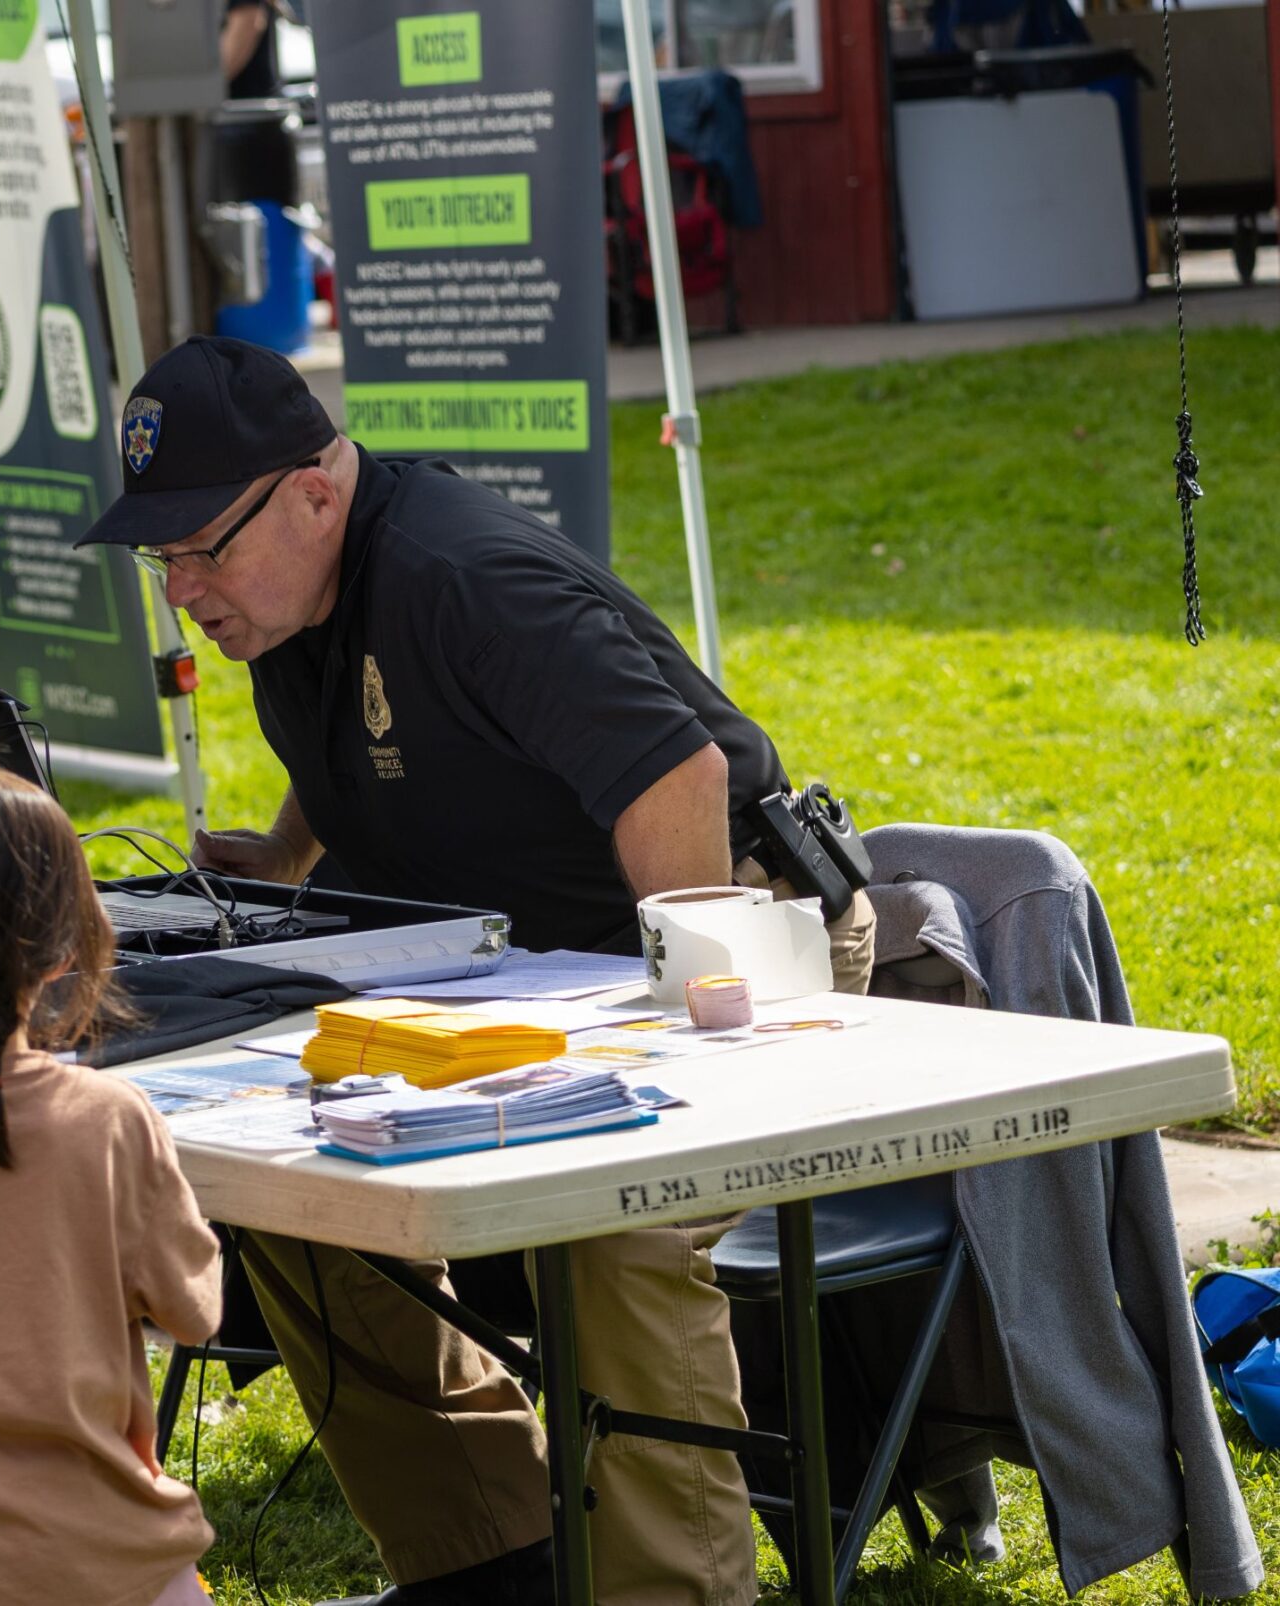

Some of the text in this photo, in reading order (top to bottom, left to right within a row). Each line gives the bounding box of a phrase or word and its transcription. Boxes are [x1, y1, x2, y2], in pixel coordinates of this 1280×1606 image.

[412, 30, 466, 66] ACCESS
[381, 191, 516, 230] YOUTH OUTREACH
[428, 398, 524, 432] COMMUNITY'S
[529, 397, 577, 431] VOICE
[369, 745, 401, 758] COMMUNITY
[373, 758, 403, 769] SERVICES
[619, 1107, 1071, 1216] ELMA CONSERVATION CLUB
